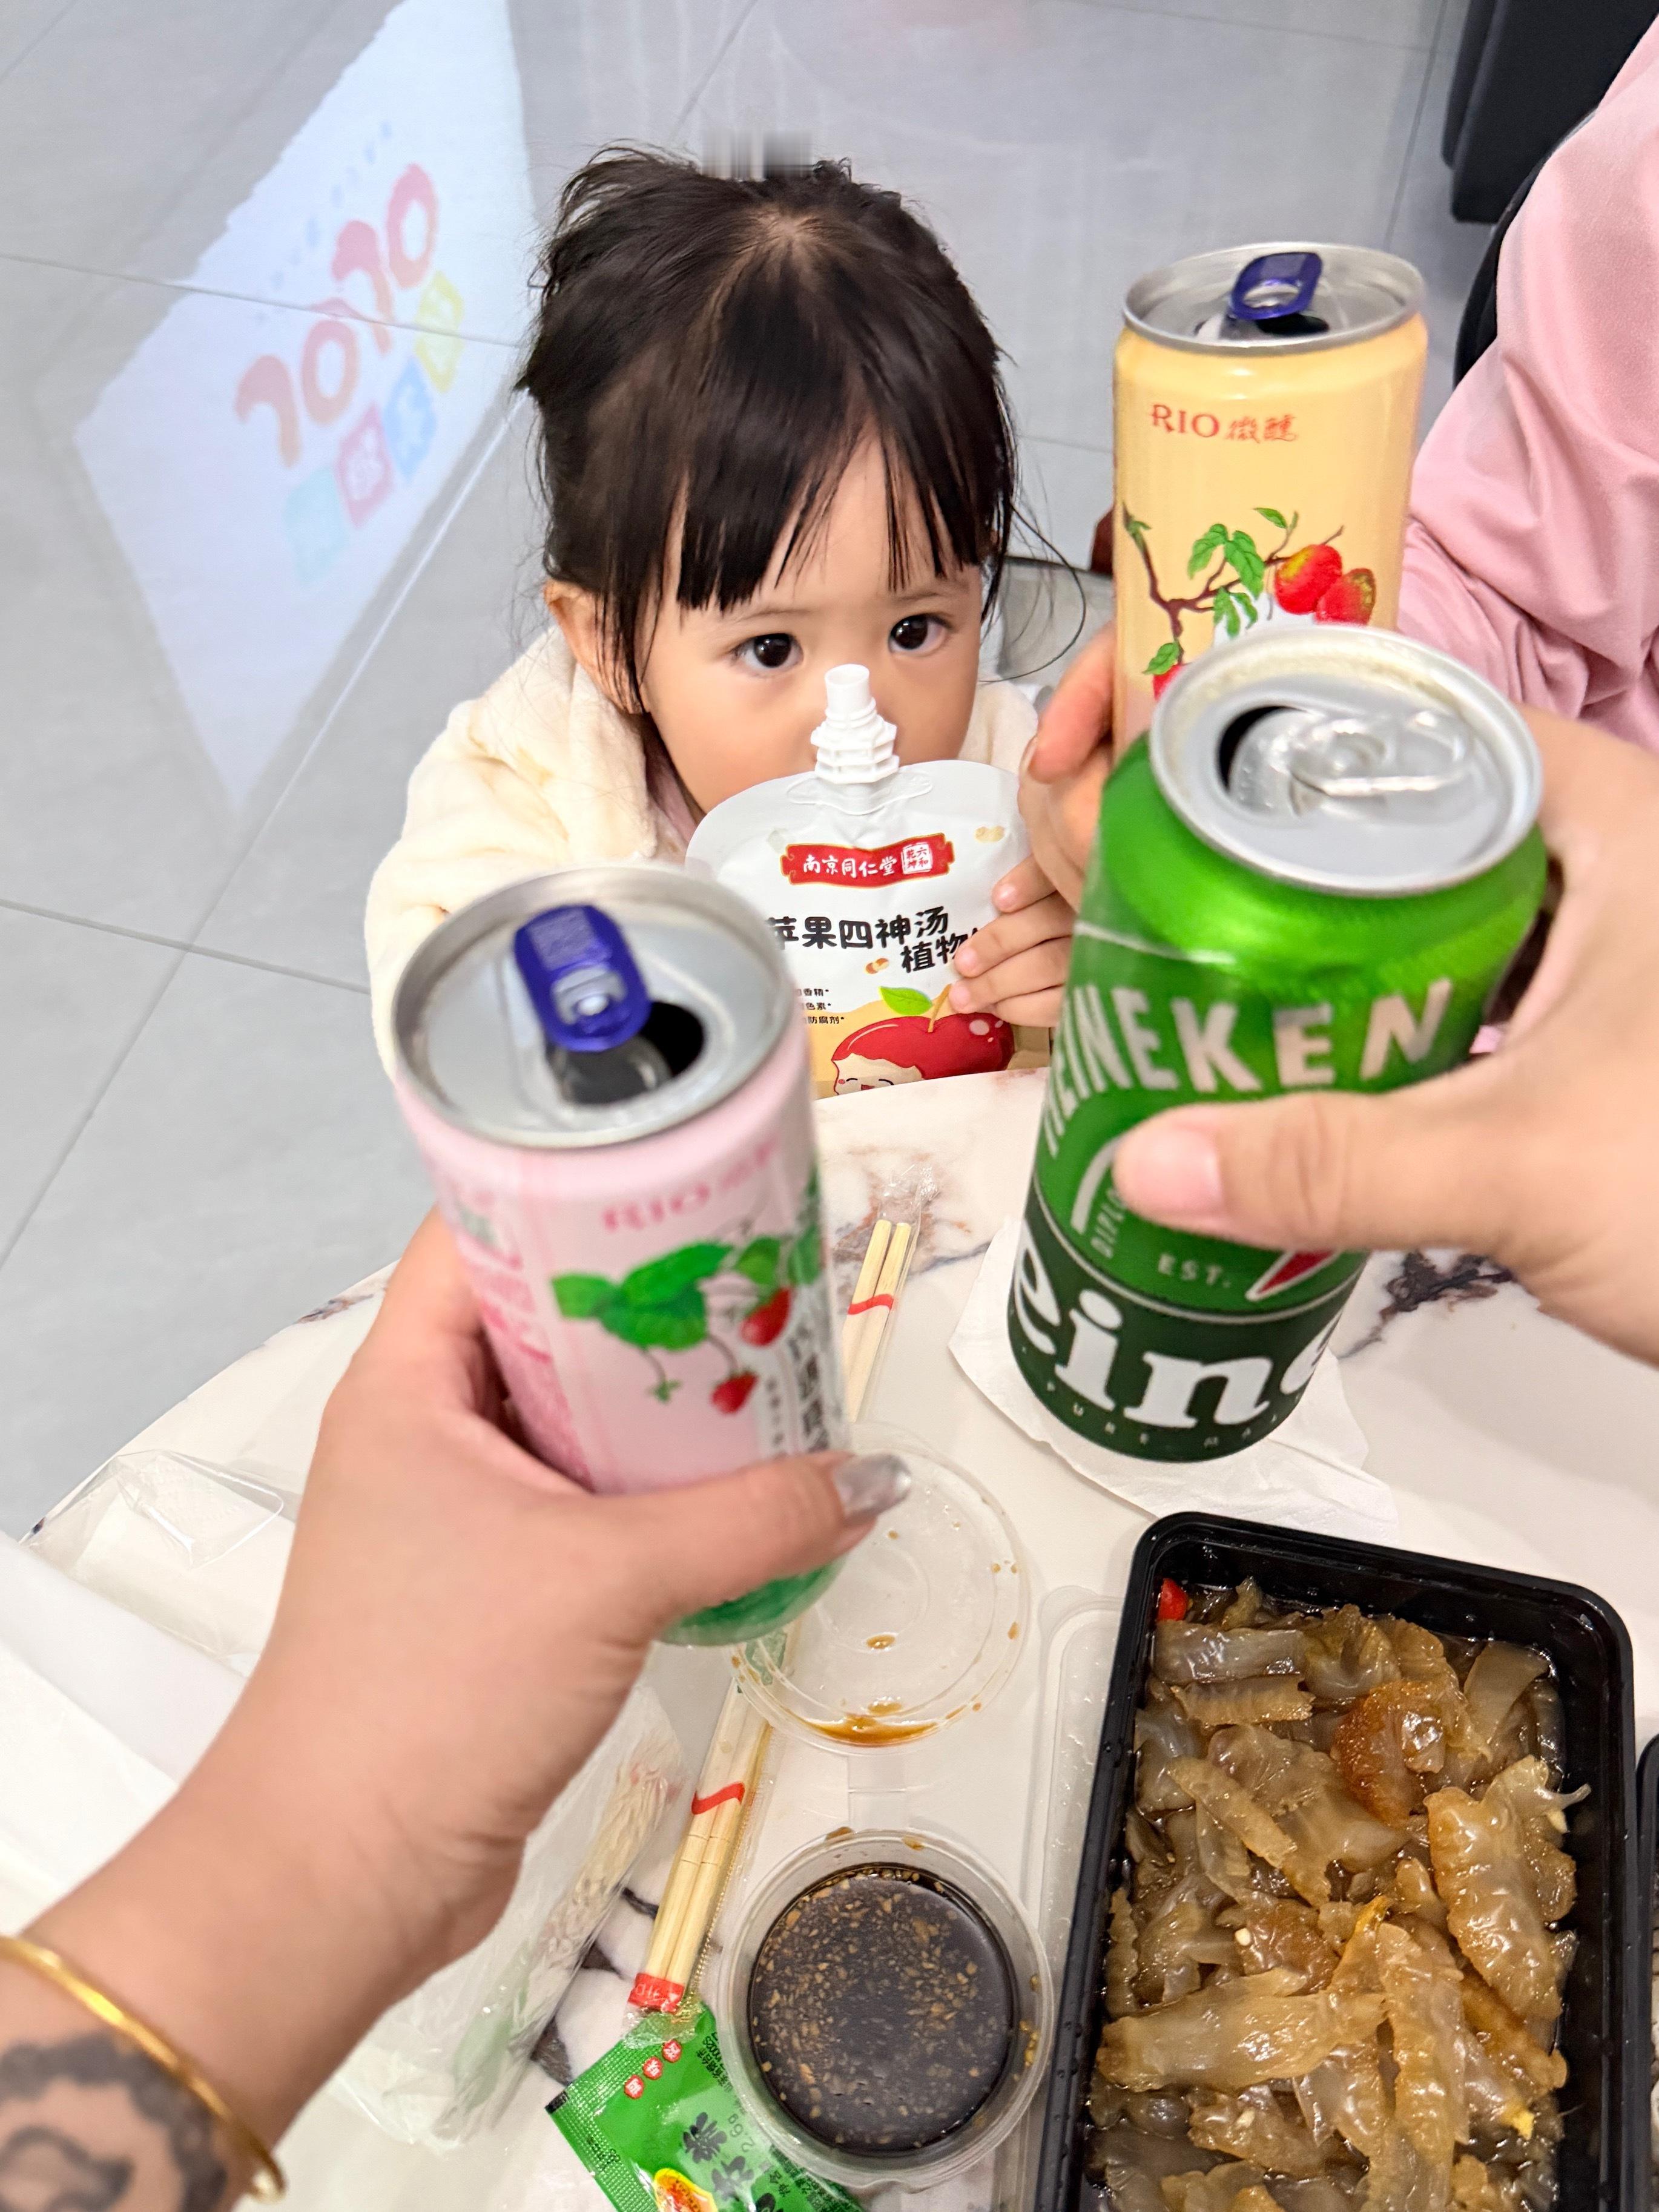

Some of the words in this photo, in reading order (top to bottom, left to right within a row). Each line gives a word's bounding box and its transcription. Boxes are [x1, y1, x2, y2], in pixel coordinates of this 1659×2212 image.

[1150, 404, 1219, 437] RIO
[803, 854, 897, 878] 南京同仁堂
[767, 906, 949, 949] 苹果四神汤
[901, 927, 980, 973] 植物
[728, 2113, 756, 2153] 2.6g
